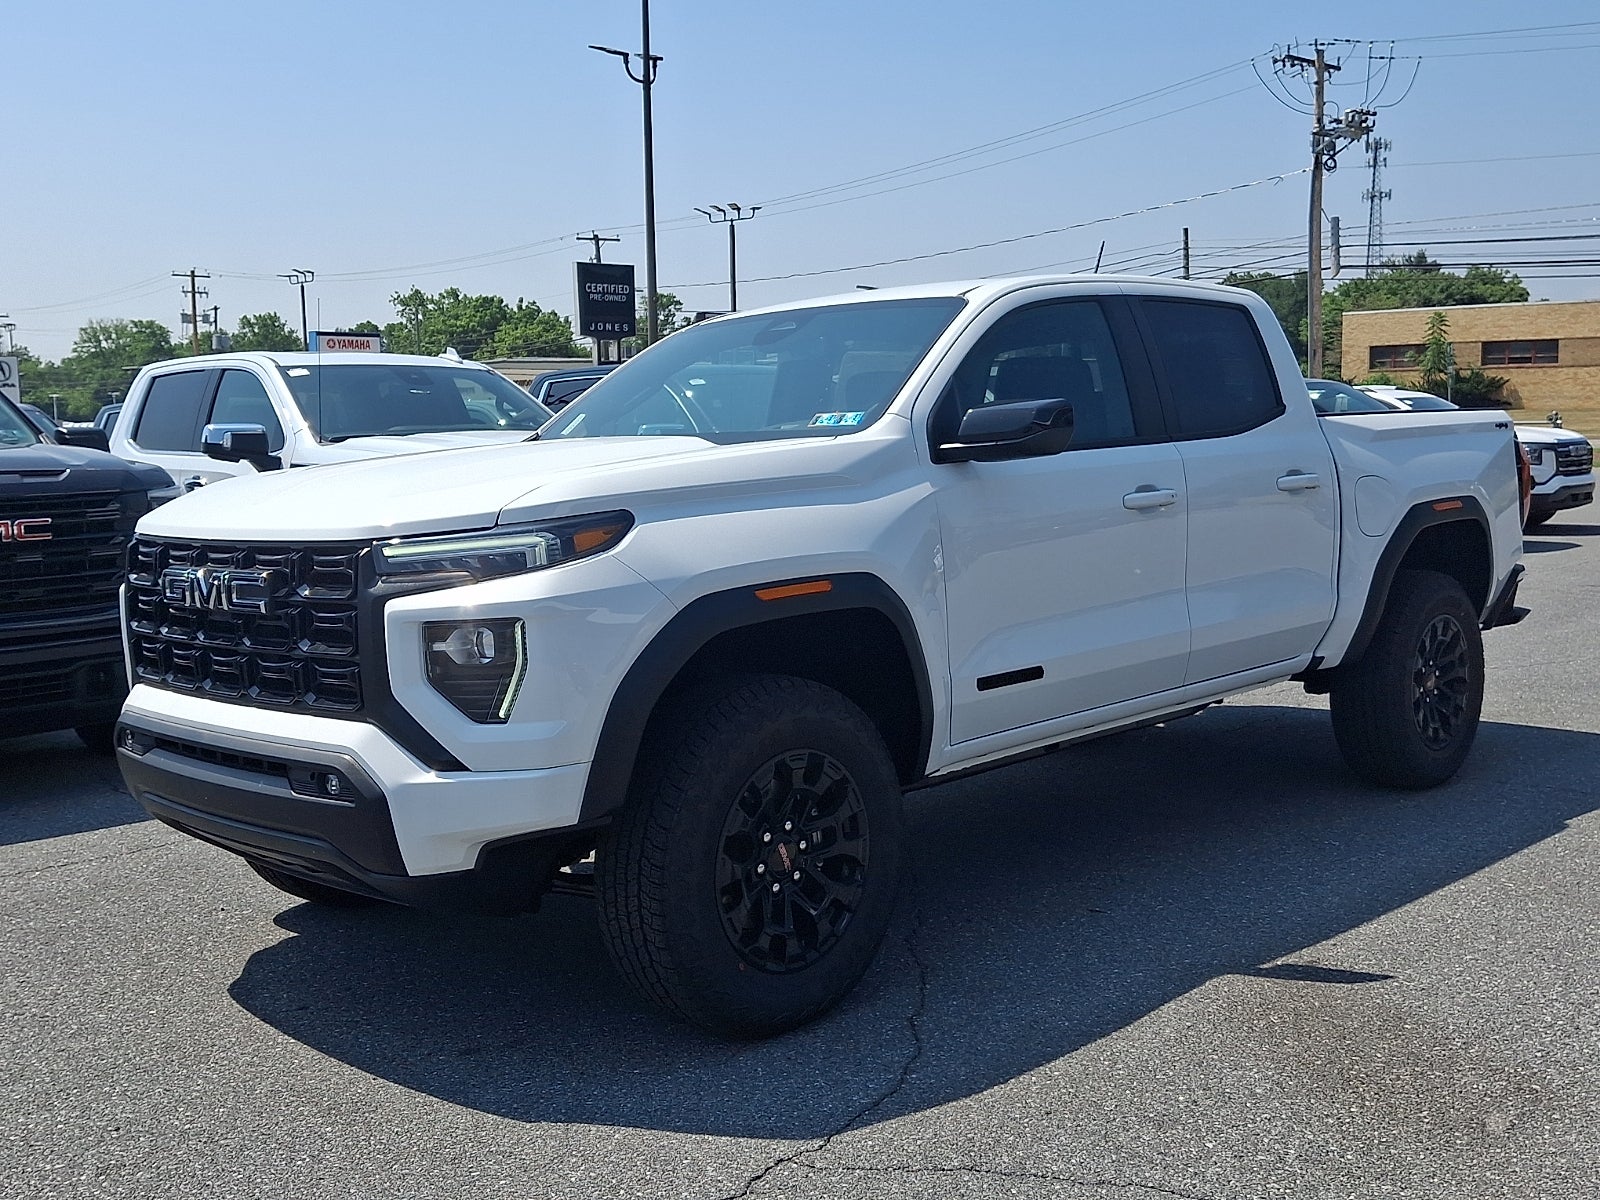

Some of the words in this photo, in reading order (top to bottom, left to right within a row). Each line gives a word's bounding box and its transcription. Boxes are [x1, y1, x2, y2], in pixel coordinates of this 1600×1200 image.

[585, 283, 630, 294] CERTIFIED
[589, 294, 627, 302] PRE-OWNED
[589, 322, 629, 332] JONES
[336, 339, 371, 350] YAMAHA
[160, 566, 273, 615] GMC
